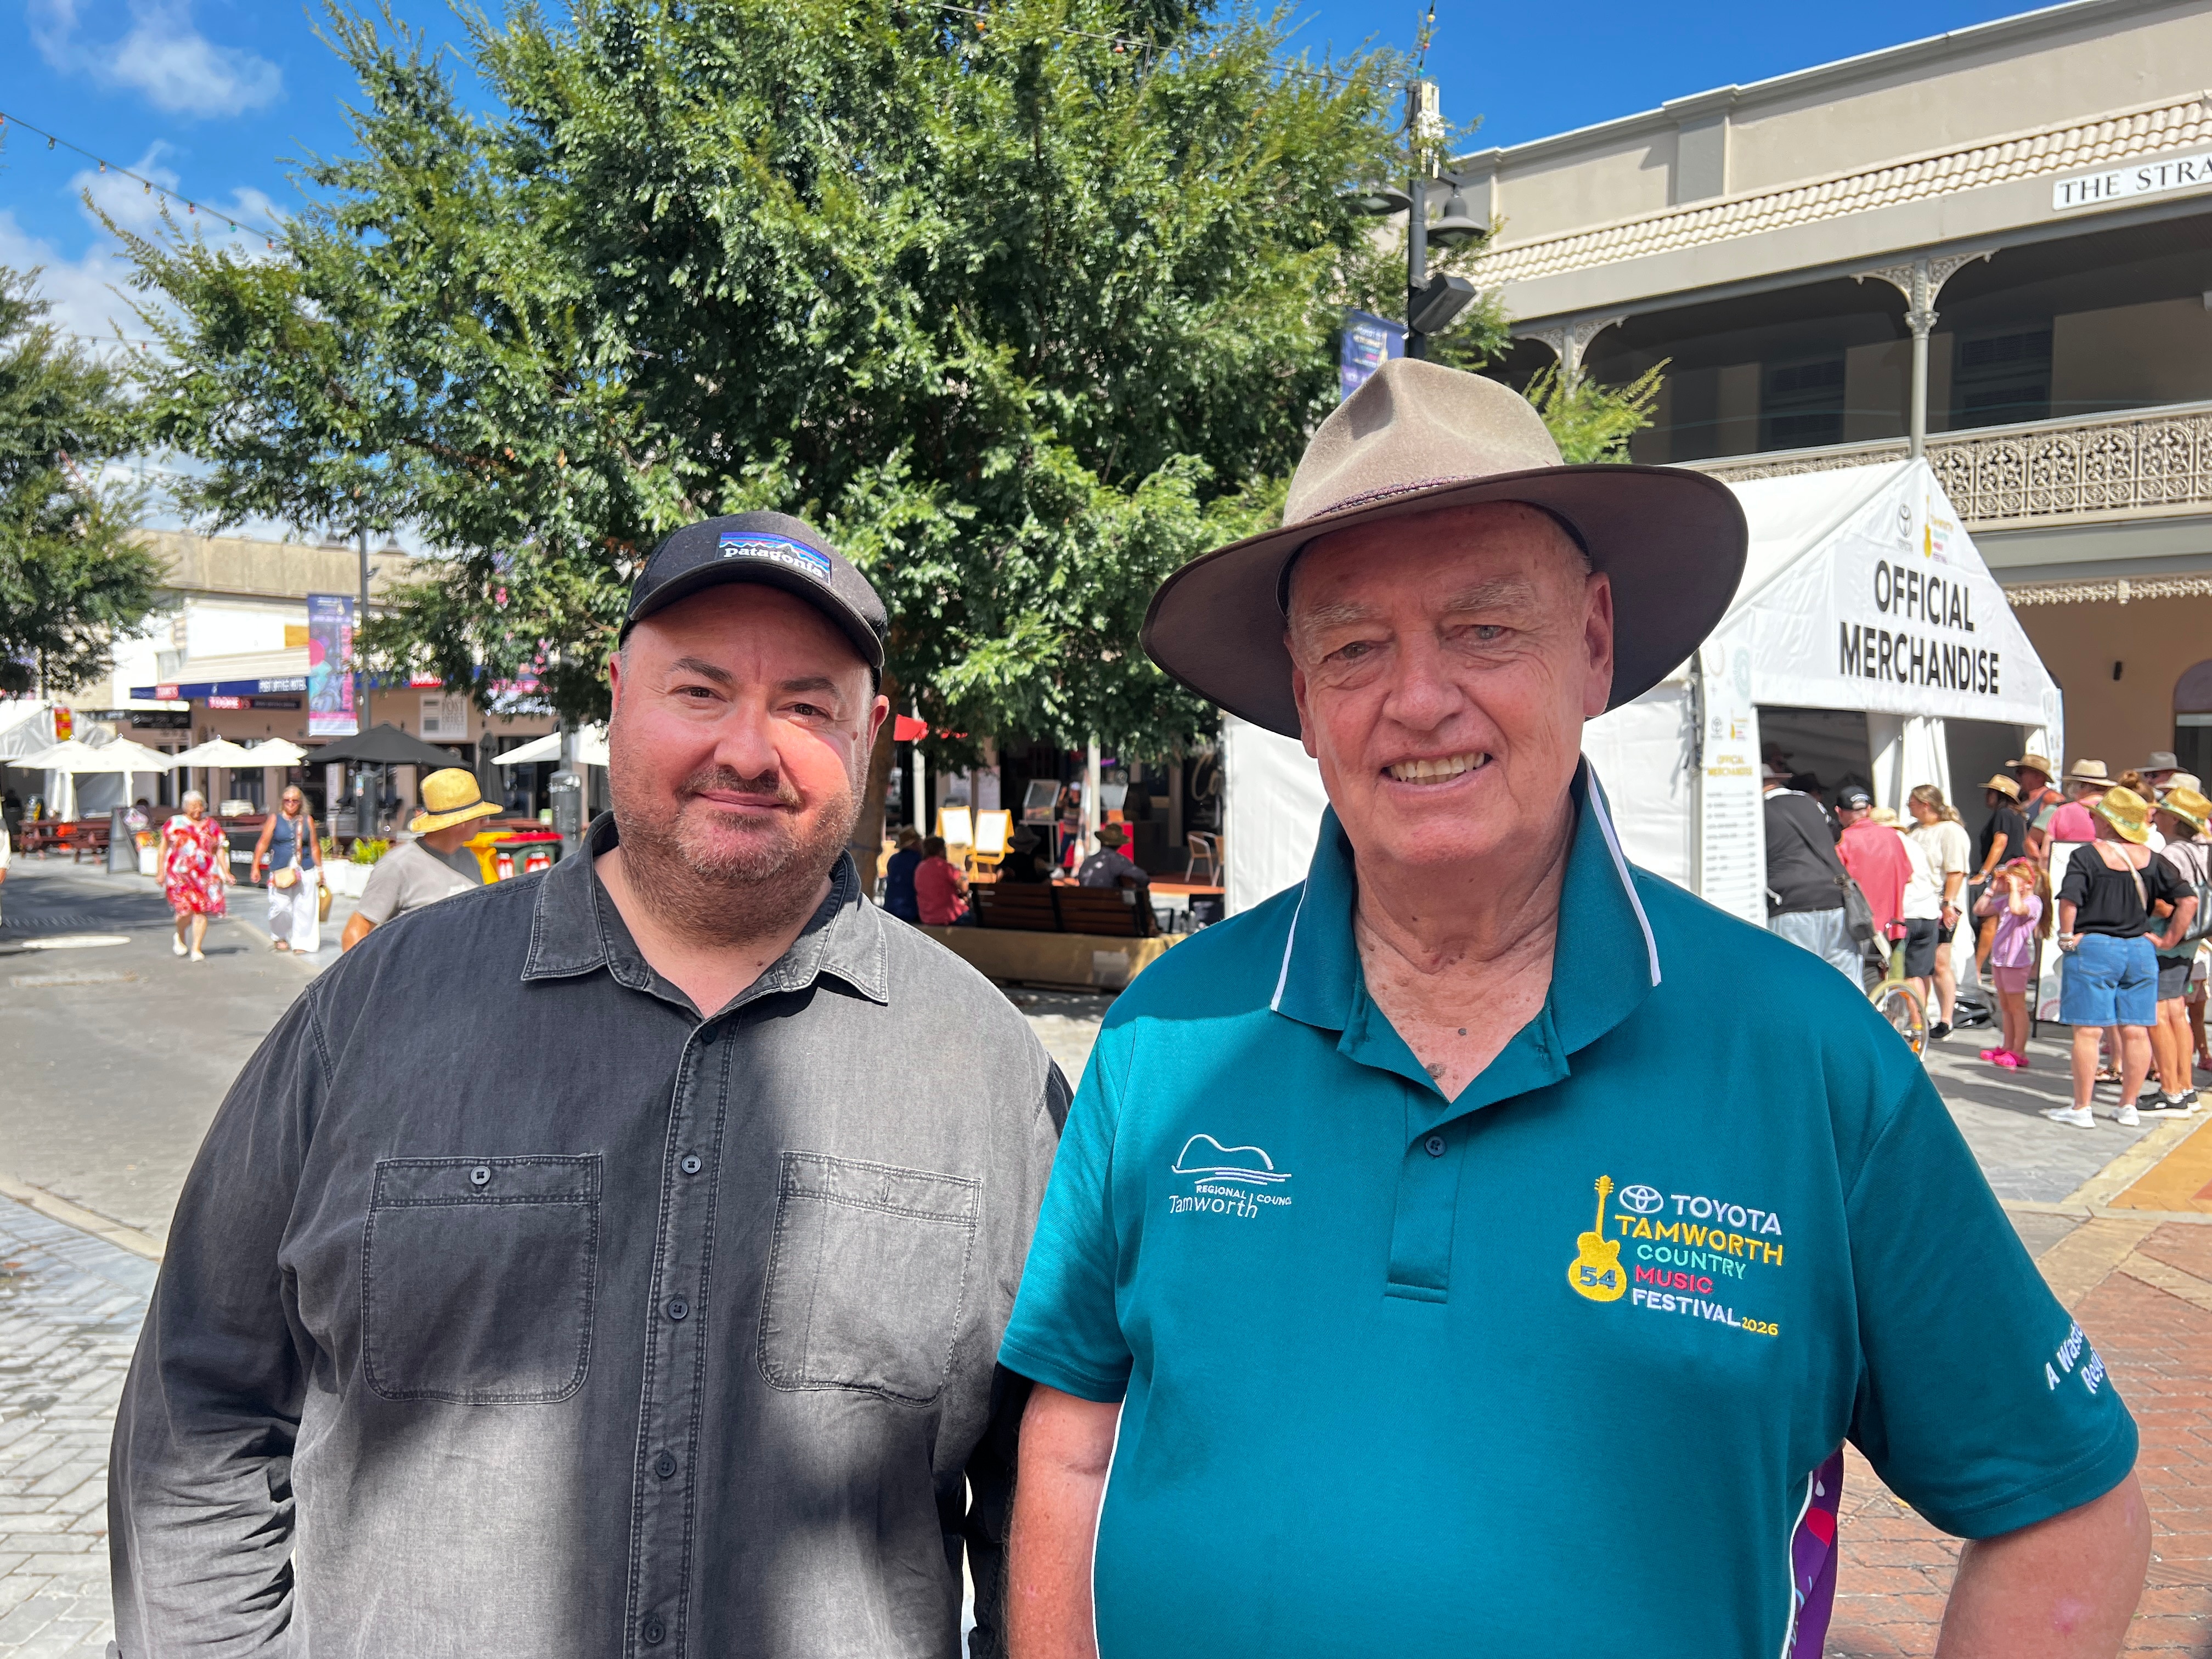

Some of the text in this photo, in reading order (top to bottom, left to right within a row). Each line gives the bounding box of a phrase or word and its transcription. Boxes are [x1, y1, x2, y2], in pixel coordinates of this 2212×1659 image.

[2059, 156, 2212, 204] THE STRA
[724, 548, 825, 578] patagonia
[1875, 560, 1974, 632] OFFICIAL
[1839, 621, 1999, 695] MERCHANDISE
[1169, 1193, 1258, 1218] Tamworth
[1196, 1185, 1246, 1199] REGIONAL
[1671, 1194, 1782, 1235] TOYOTA
[1615, 1215, 1784, 1266] TAMWORTH
[1579, 1265, 1617, 1290] 54
[1637, 1244, 1746, 1279] COUNTRY
[1635, 1265, 1713, 1294] MUSIC
[1633, 1288, 1779, 1336] FESTIVAL 2026
[2046, 1362, 2061, 1390] A
